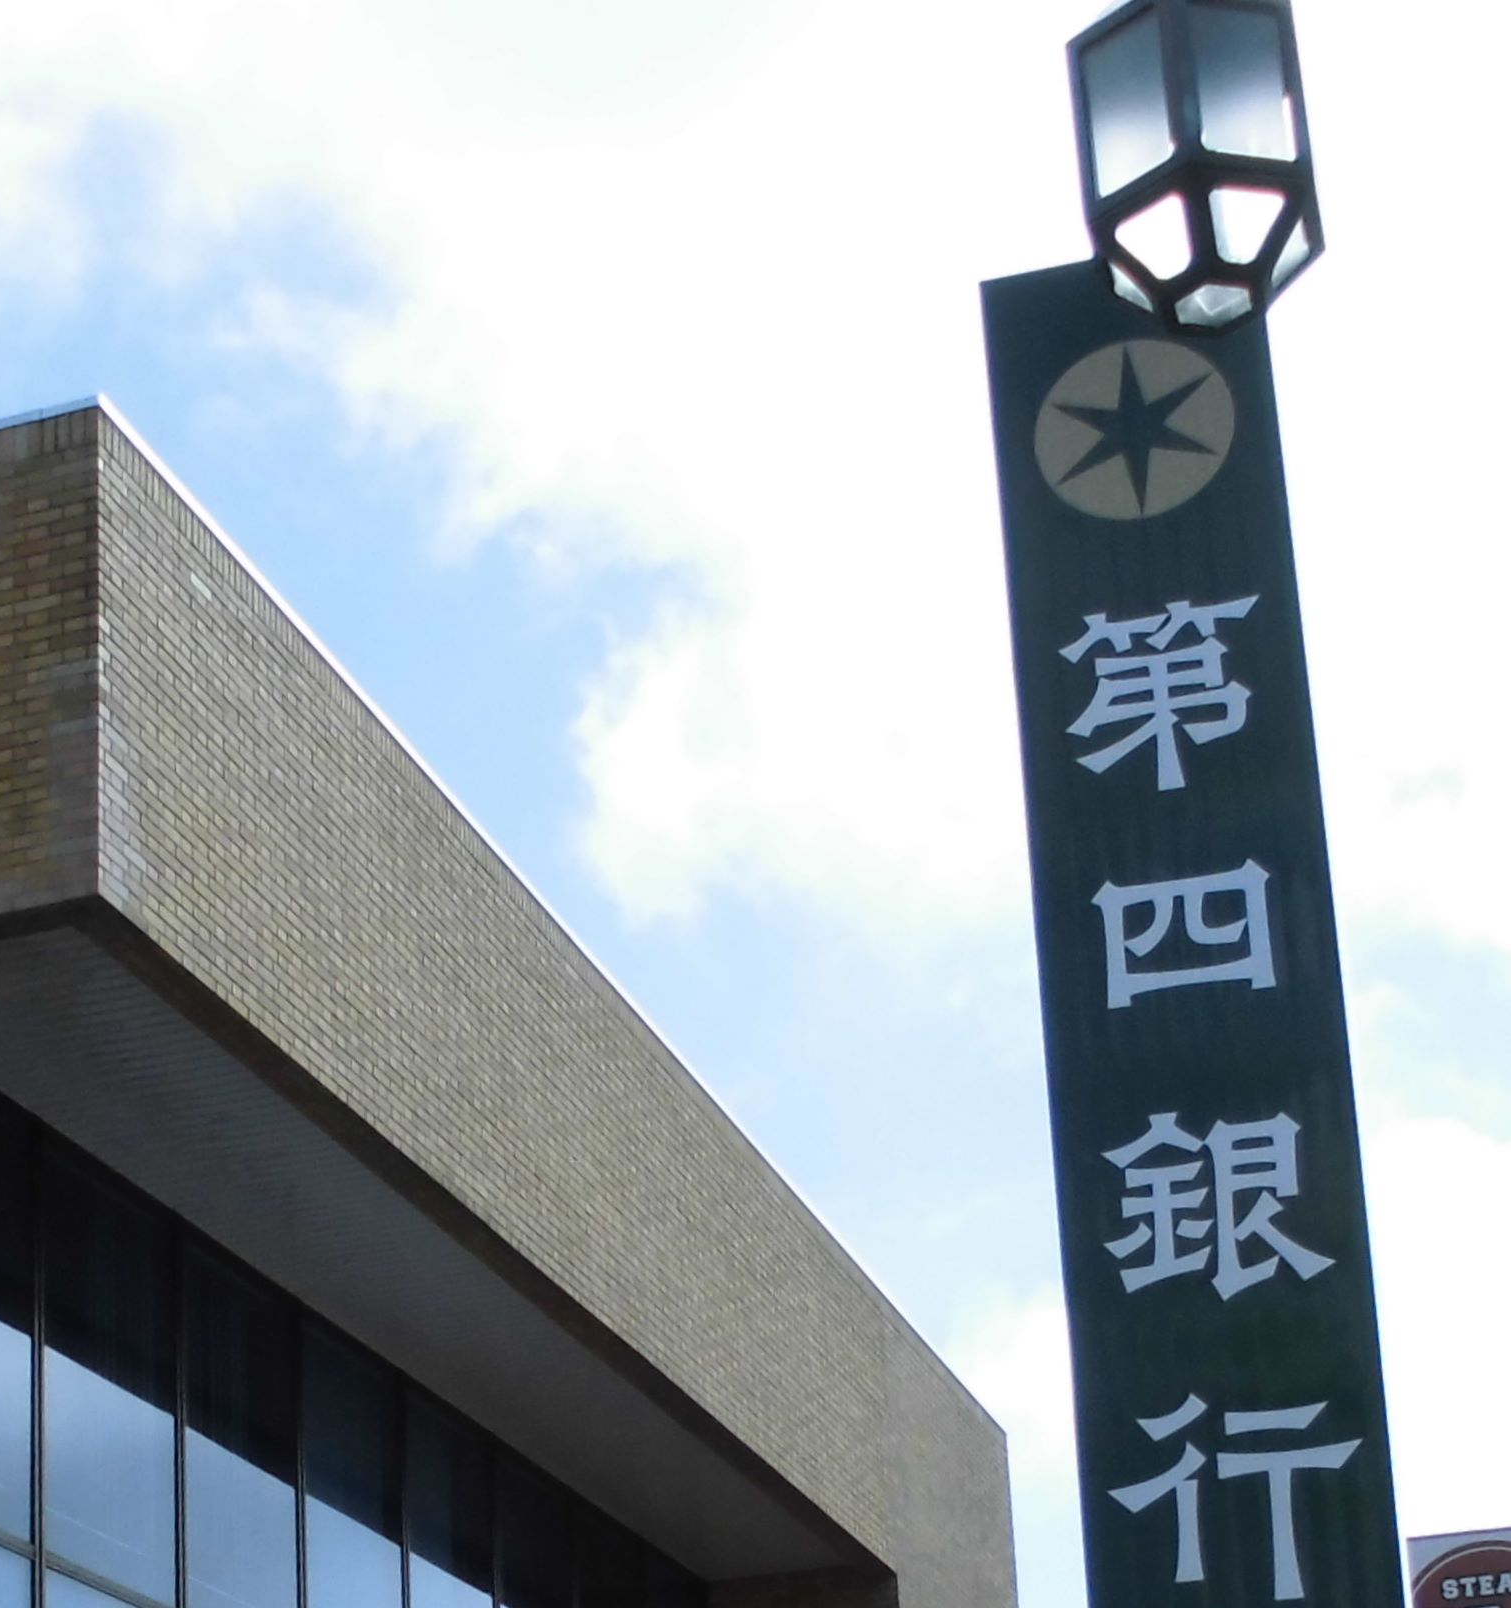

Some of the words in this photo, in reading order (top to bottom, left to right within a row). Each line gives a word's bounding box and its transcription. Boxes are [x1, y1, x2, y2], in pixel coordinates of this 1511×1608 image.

[1058, 593, 1362, 1599] 第四銀行
[1442, 1573, 1511, 1600] STEA
